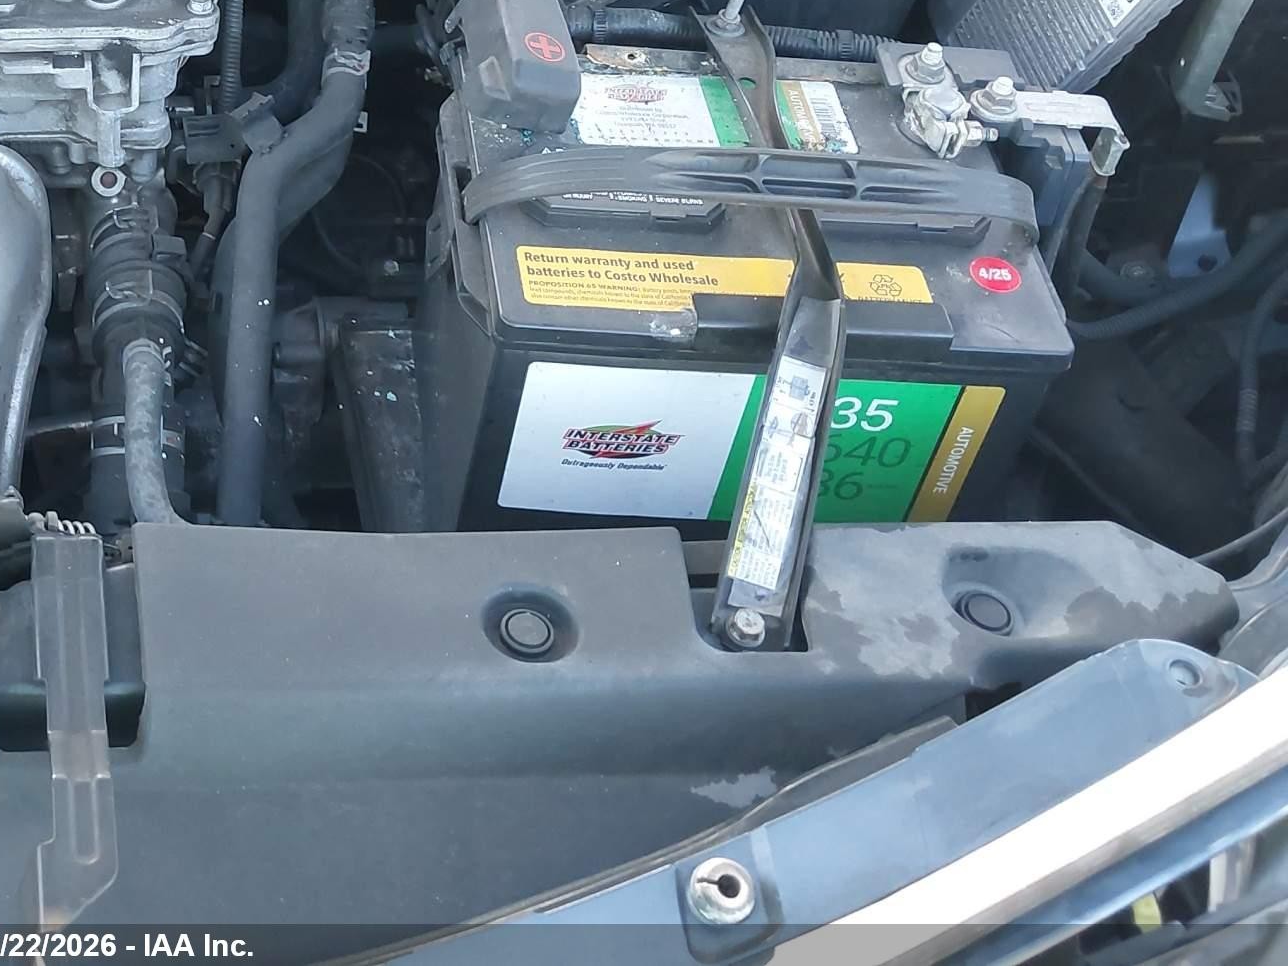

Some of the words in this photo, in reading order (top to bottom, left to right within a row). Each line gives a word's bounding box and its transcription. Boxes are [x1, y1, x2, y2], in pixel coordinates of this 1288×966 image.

[524, 251, 569, 264] Return
[572, 255, 631, 270] warranty
[634, 258, 660, 269] and
[663, 260, 694, 271] used
[526, 265, 585, 278] batteries
[587, 268, 601, 279] to
[604, 269, 647, 283] Costco
[649, 271, 719, 286] Wholesale
[978, 267, 1011, 281] 4/25
[830, 395, 899, 432] 35
[565, 428, 680, 445] INTERSTATE
[565, 440, 667, 454] BATTERIES
[561, 458, 615, 470] Outrageously
[932, 425, 974, 494] AUTOMOTIVE
